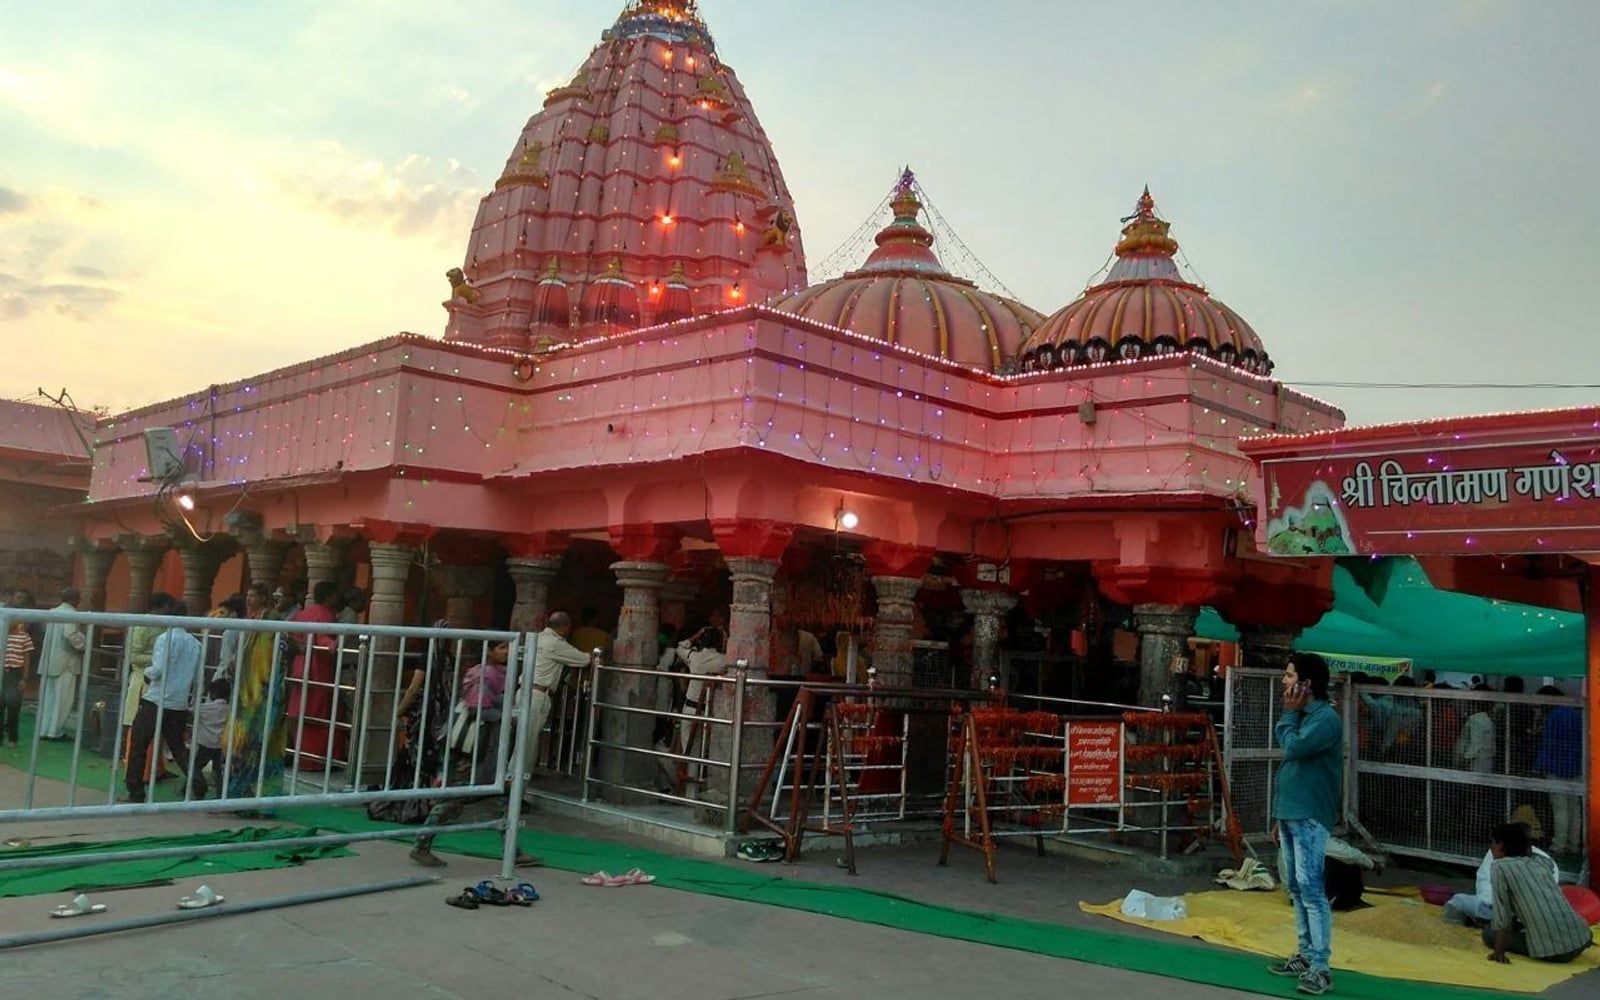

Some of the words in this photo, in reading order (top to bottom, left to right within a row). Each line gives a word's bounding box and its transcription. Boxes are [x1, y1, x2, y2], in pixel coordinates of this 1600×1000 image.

[1342, 461, 1375, 507] श्री
[1379, 460, 1508, 506] चिन्तामण
[1513, 449, 1600, 500] गणेश
